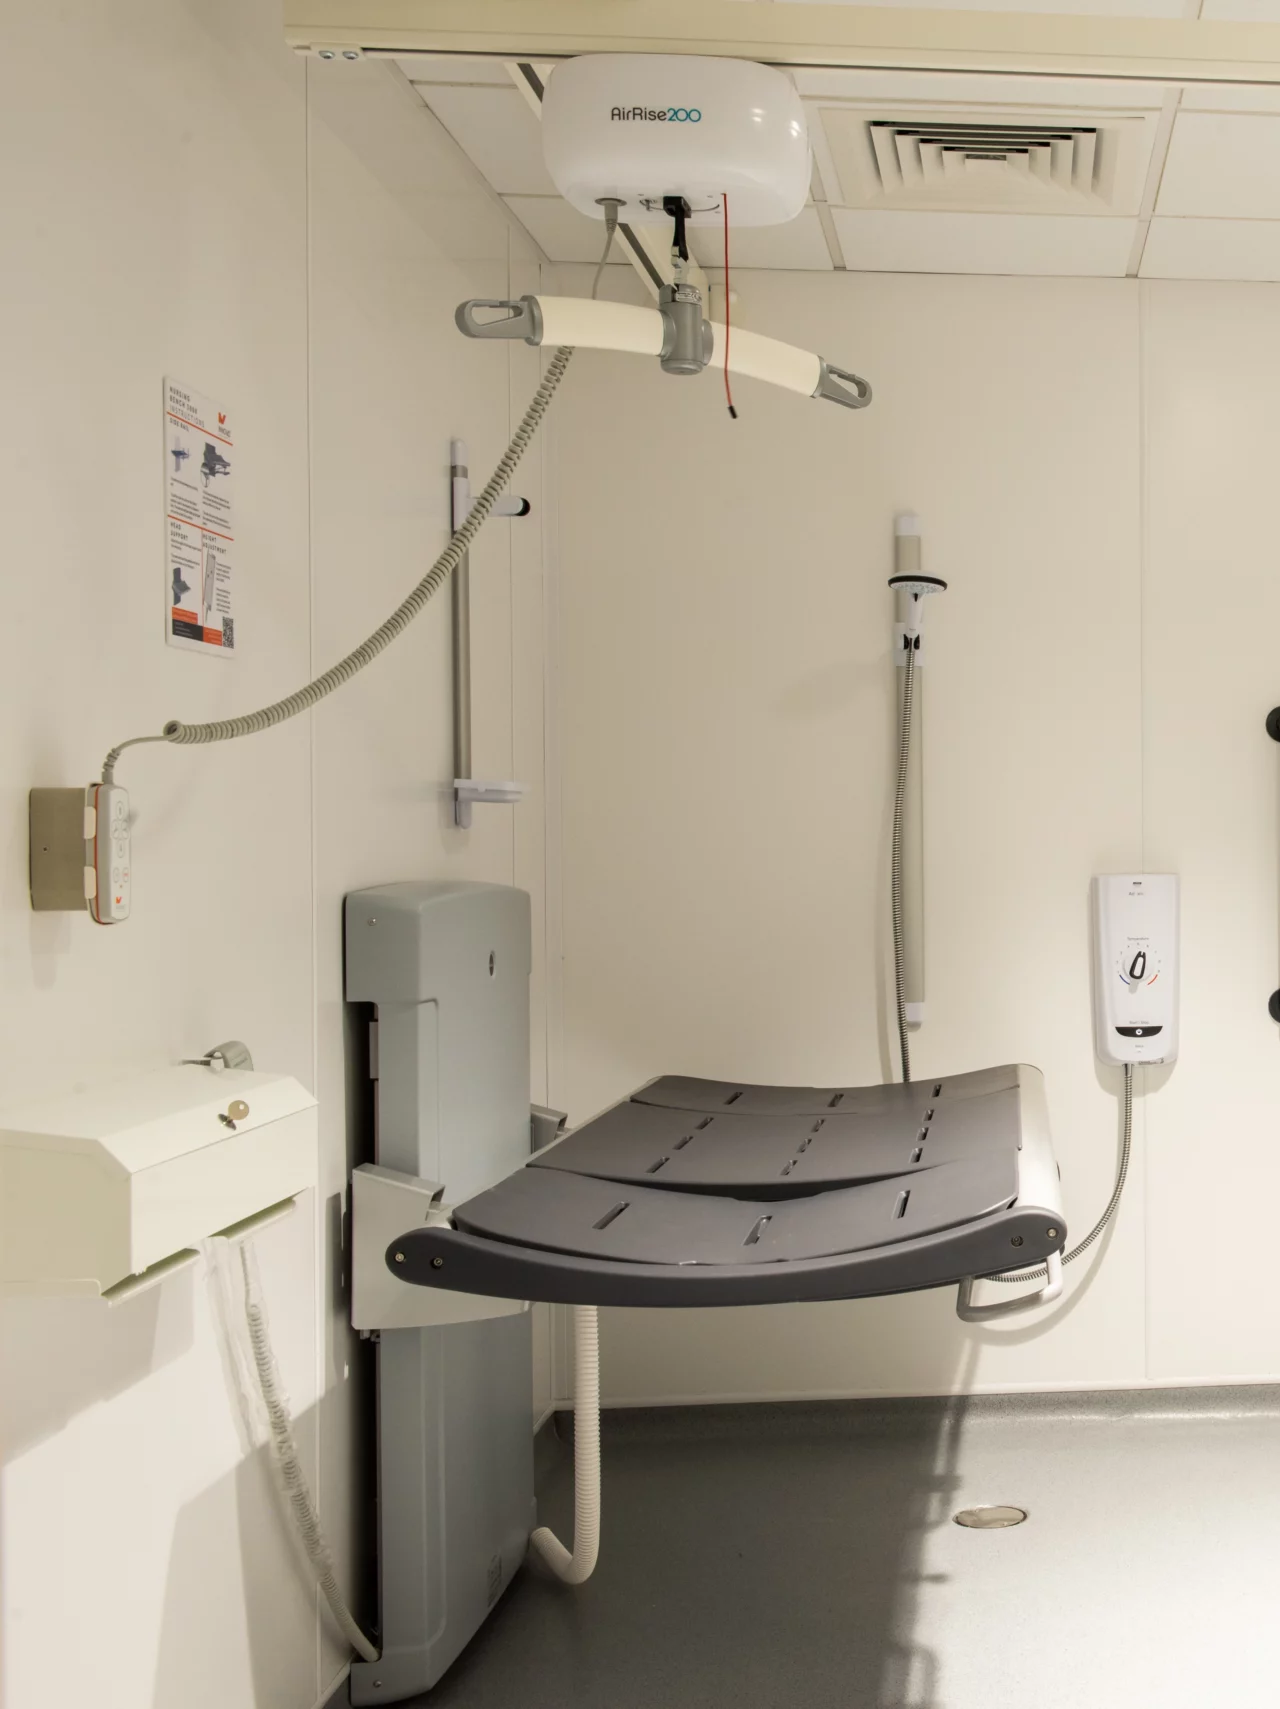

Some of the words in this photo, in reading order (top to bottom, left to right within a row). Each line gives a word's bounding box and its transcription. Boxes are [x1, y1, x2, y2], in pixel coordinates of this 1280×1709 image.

[611, 107, 702, 122] AirRise200
[169, 386, 190, 402] NURSING
[169, 395, 186, 408] BENCH
[169, 405, 205, 428] INSTRUCTIONS
[170, 530, 188, 541] SUPPORT
[202, 533, 217, 543] HEIGHT
[202, 543, 227, 554] ADJUSTMENT
